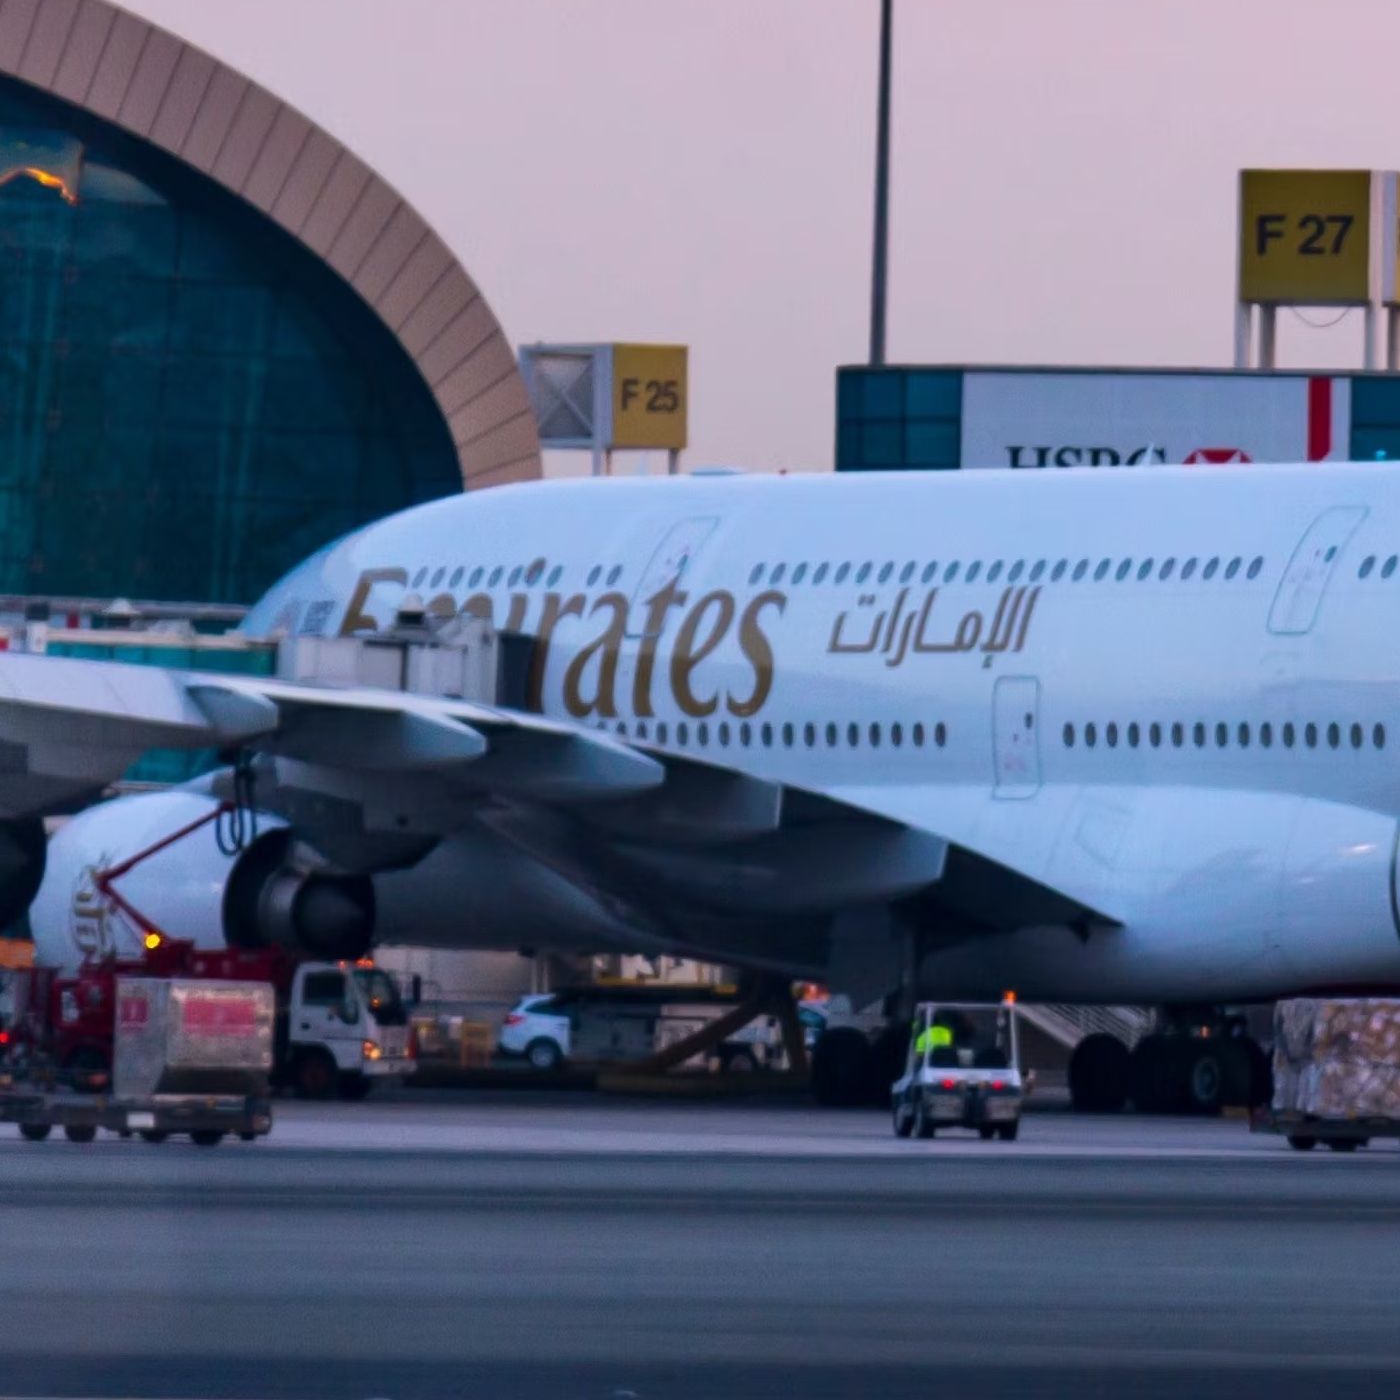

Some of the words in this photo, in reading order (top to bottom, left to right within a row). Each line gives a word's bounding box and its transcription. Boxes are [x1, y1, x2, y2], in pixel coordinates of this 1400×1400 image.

[1256, 214, 1287, 256] F
[1298, 214, 1355, 256] 27
[621, 377, 640, 412] F
[645, 379, 680, 415] 25
